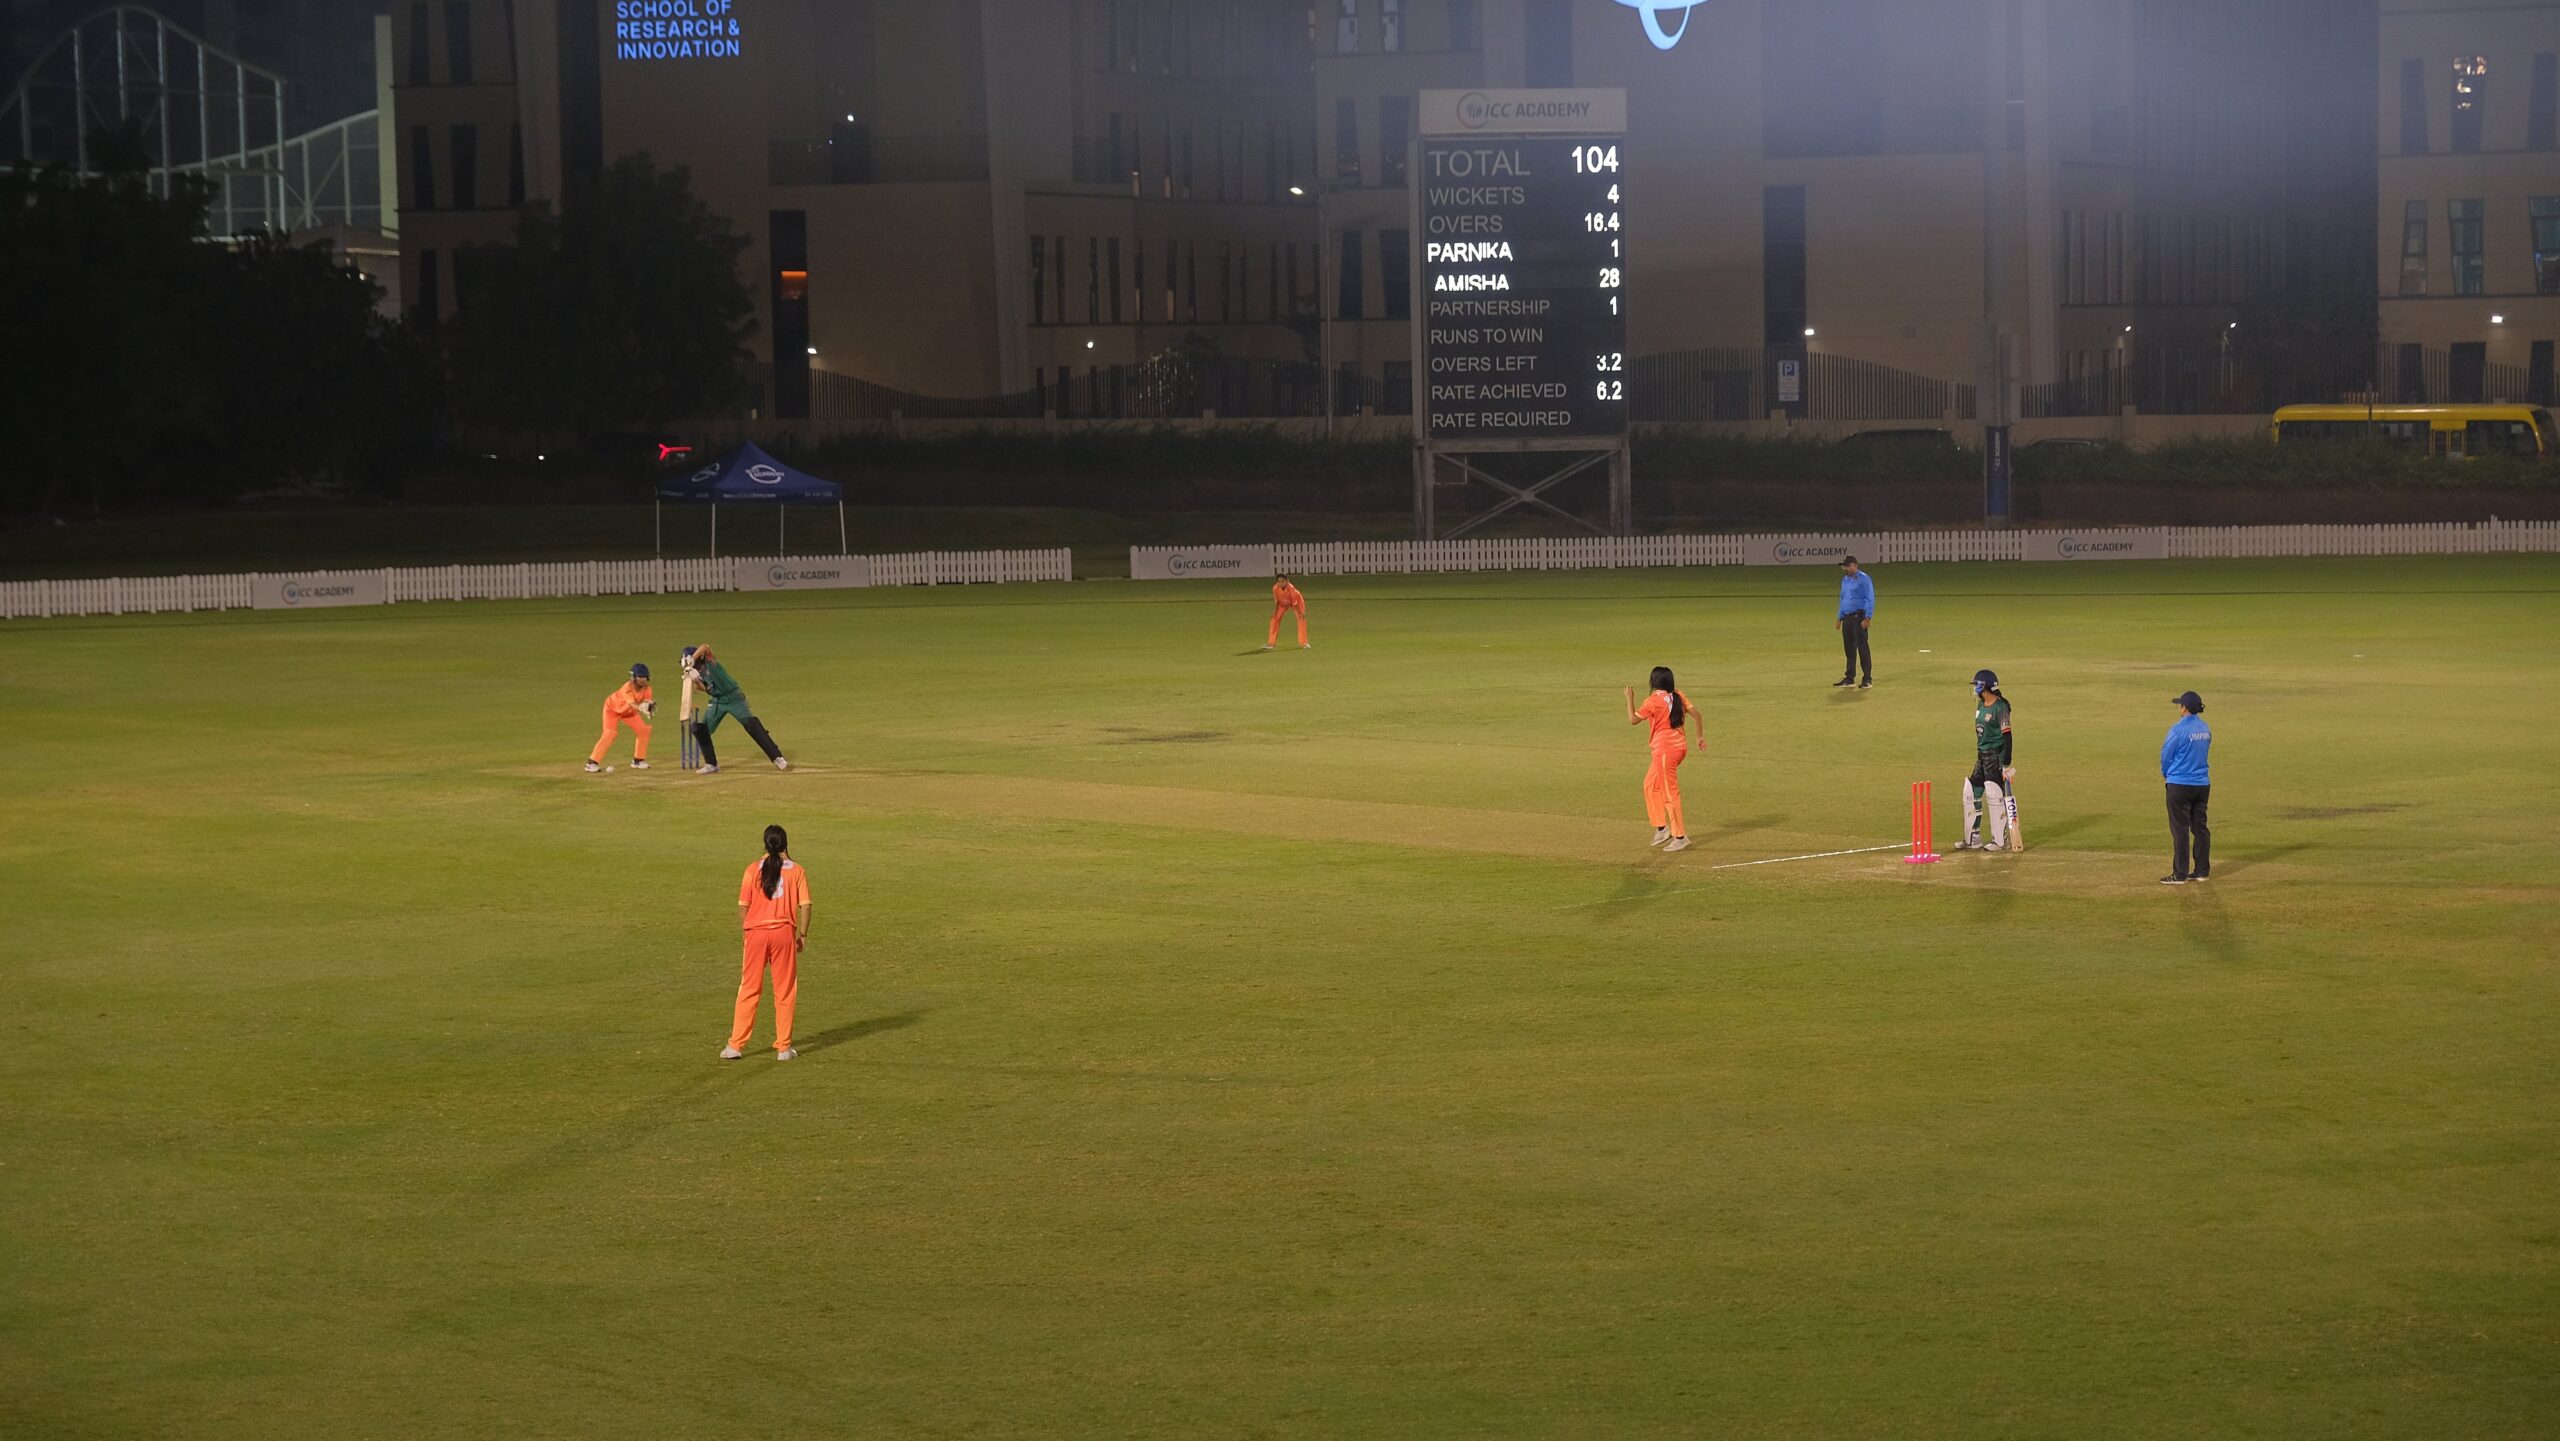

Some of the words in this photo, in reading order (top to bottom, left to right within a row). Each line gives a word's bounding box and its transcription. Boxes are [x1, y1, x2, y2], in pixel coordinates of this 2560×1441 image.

[616, 0, 699, 19] SCHOOL
[706, 0, 732, 16] OF
[617, 19, 723, 39] RESEARCH
[728, 18, 740, 36] &
[617, 39, 740, 60] INNOVATION
[1485, 103, 1511, 118] ICC
[1515, 102, 1590, 118] ACADEMY
[1428, 149, 1531, 177] TOTAL
[1571, 145, 1619, 173] 104
[1429, 186, 1525, 206] WICKETS
[1607, 184, 1619, 204] 4
[1429, 215, 1503, 234] OVERS
[1584, 212, 1620, 232] 16.4
[1427, 241, 1513, 262] PARNIKA
[1611, 239, 1619, 257] 1
[1434, 273, 1509, 291] AMISHA
[1599, 268, 1620, 287] 28
[1430, 300, 1550, 316] PARTNERSHIP
[1609, 296, 1617, 315] 1
[1431, 329, 1479, 344] RUNS
[1483, 329, 1507, 343] TO
[1510, 328, 1543, 343] WIN
[1431, 356, 1491, 372] OVERS
[1496, 356, 1537, 371] LEFT
[1596, 353, 1621, 371] 3.2
[1784, 363, 1793, 376] P
[1431, 385, 1475, 400] RATE
[1479, 383, 1567, 399] ACHIEVED
[1596, 381, 1622, 400] 6.2
[1432, 413, 1476, 428] RATE
[1481, 411, 1571, 427] REQUIRED
[1788, 547, 1804, 557] ICC
[1806, 547, 1848, 556] ACADEMY
[2073, 543, 2089, 552] ICC
[2090, 542, 2134, 552] ACADEMY
[1183, 560, 1198, 569] ICC
[1200, 559, 1242, 569] ACADEMY
[783, 570, 798, 581] ICC
[800, 570, 841, 580] ACADEMY
[314, 586, 355, 597] ACADEMY
[2007, 797, 2017, 818] TON
